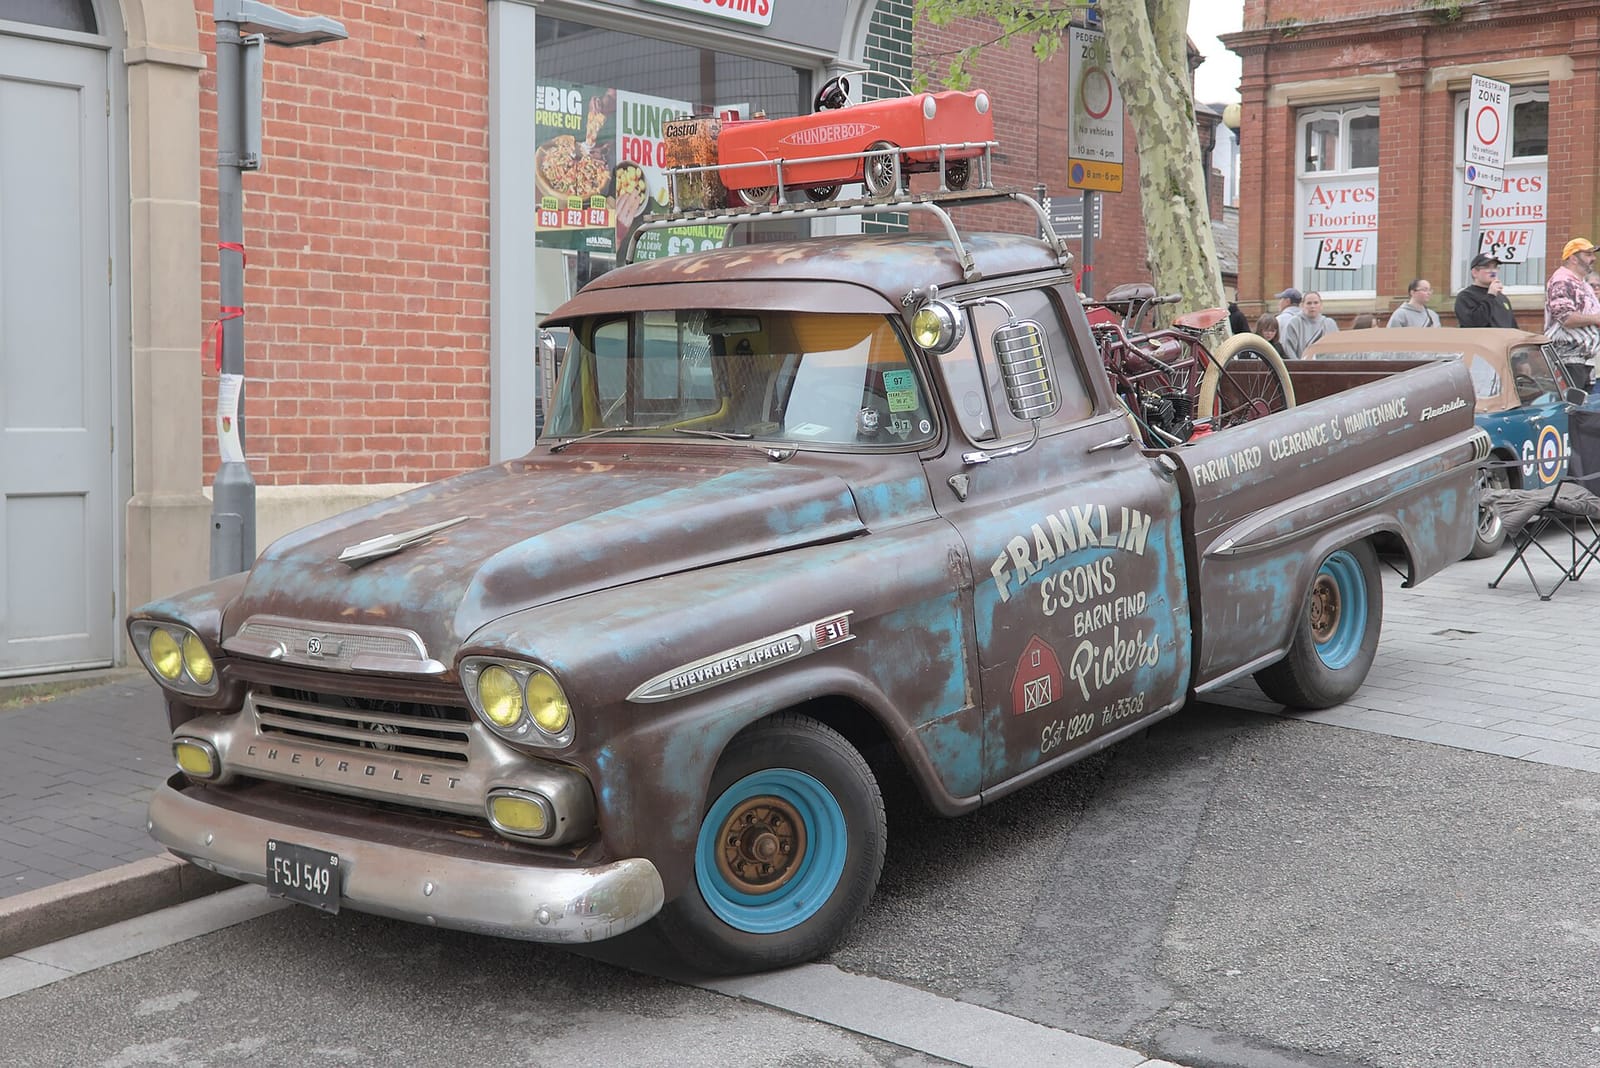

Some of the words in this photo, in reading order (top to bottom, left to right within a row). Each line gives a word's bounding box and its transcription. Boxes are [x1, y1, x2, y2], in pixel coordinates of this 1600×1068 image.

[1075, 31, 1105, 43] PEDEST
[1082, 45, 1111, 63] ZOE
[545, 86, 582, 115] BIG
[1479, 90, 1501, 104] ZONE
[536, 110, 563, 128] PRICE
[564, 113, 582, 130] CUT
[666, 123, 698, 138] Castrol
[791, 124, 866, 145] THUNDERBOLT
[622, 136, 653, 167] FOR
[1308, 184, 1376, 210] Ayres
[541, 211, 558, 226] £10
[567, 210, 582, 225] £12
[590, 209, 605, 225] £14
[1308, 211, 1377, 228] Flooring
[708, 224, 727, 239] PIZZ
[1485, 230, 1529, 246] SAVE
[1324, 238, 1363, 253] SAVE
[893, 377, 903, 385] 97
[1193, 455, 1230, 487] FARM
[1230, 446, 1263, 476] YARD
[1268, 422, 1330, 462] CLEARANCE
[1331, 414, 1343, 442] &
[1344, 396, 1409, 436] MAINTENANCE
[990, 503, 1152, 604] FRANKLIN
[1073, 602, 1113, 638] BARN
[1114, 590, 1146, 623] FIND
[825, 621, 845, 640] 31
[309, 639, 321, 652] 59
[670, 657, 745, 691] CHEVROLET
[748, 640, 795, 665] APACHE
[1069, 625, 1160, 702] Pickers
[1040, 720, 1066, 753] Est
[1065, 713, 1095, 741] 1920
[247, 745, 461, 789] CHEVROLET
[268, 841, 277, 851] 19
[329, 855, 339, 866] 59
[274, 857, 301, 888] FSJ
[304, 864, 330, 895] 549
